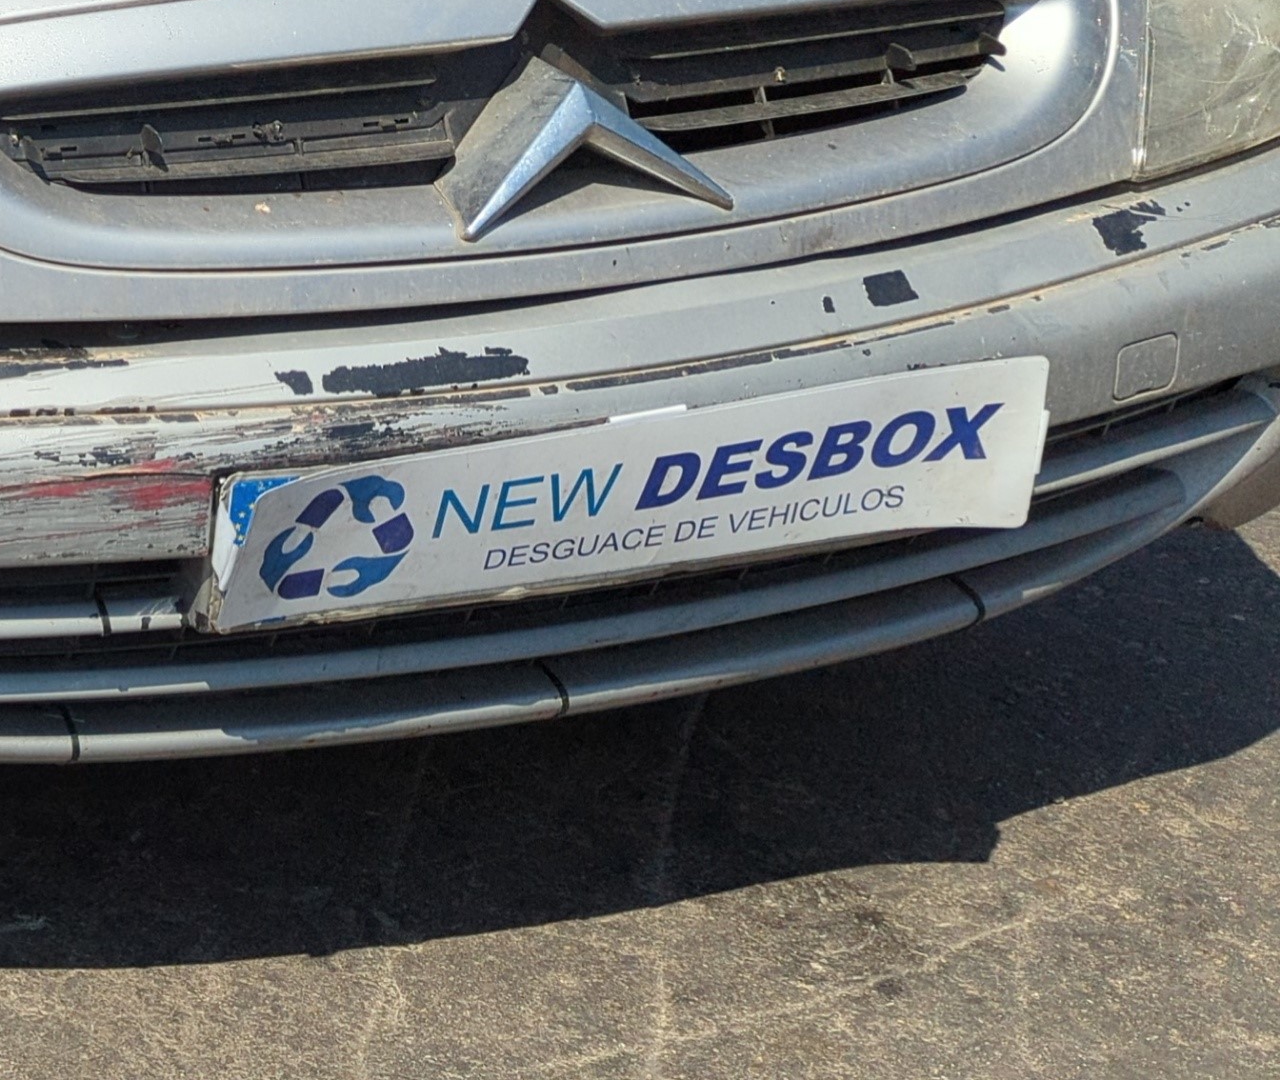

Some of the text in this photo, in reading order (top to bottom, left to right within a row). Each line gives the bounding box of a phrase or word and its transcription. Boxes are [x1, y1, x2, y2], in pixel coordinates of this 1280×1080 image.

[432, 403, 1005, 539] NEW DESBOX
[483, 485, 905, 571] DESGUACE DE VEHICULOS
